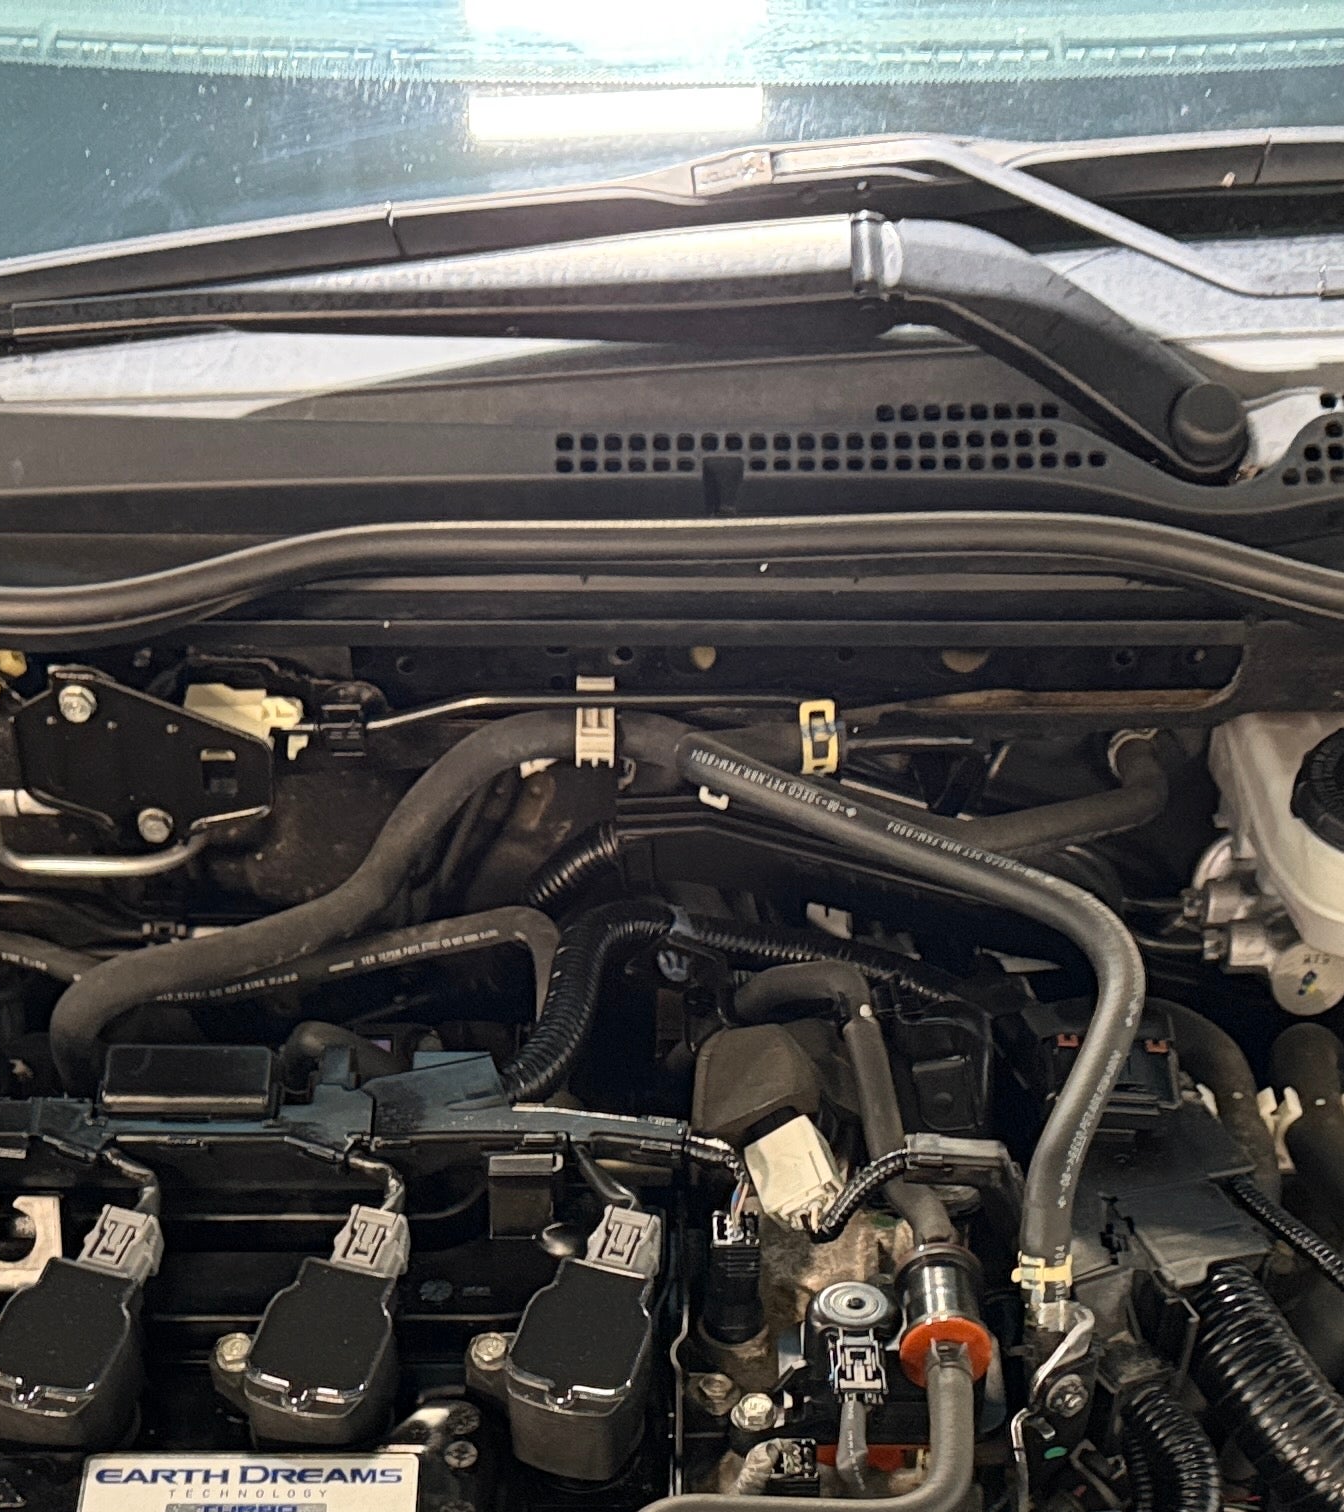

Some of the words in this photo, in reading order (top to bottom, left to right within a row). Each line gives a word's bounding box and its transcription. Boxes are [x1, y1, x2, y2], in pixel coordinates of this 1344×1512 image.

[95, 1467, 229, 1485] EARTH
[238, 1465, 404, 1485] DREAMS
[168, 1489, 329, 1499] TECHNOLOGY
